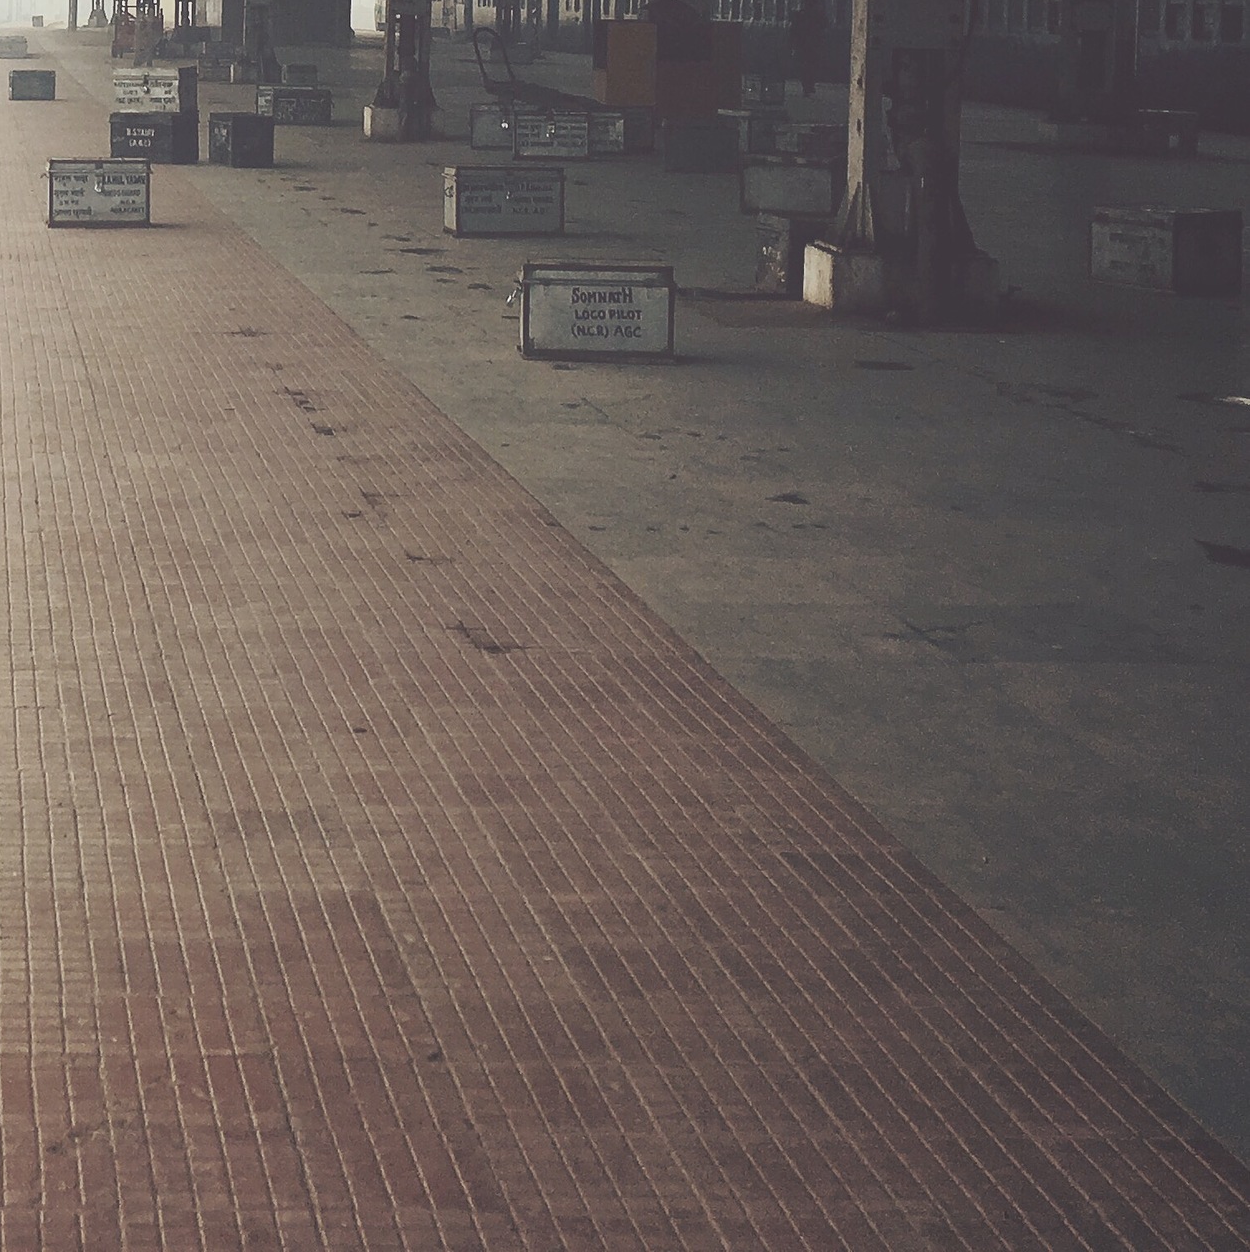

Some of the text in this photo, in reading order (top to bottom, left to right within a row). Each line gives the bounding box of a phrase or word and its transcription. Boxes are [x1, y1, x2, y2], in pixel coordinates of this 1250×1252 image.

[574, 309, 643, 320] LOCO PILOT
[613, 325, 642, 338] AGC
